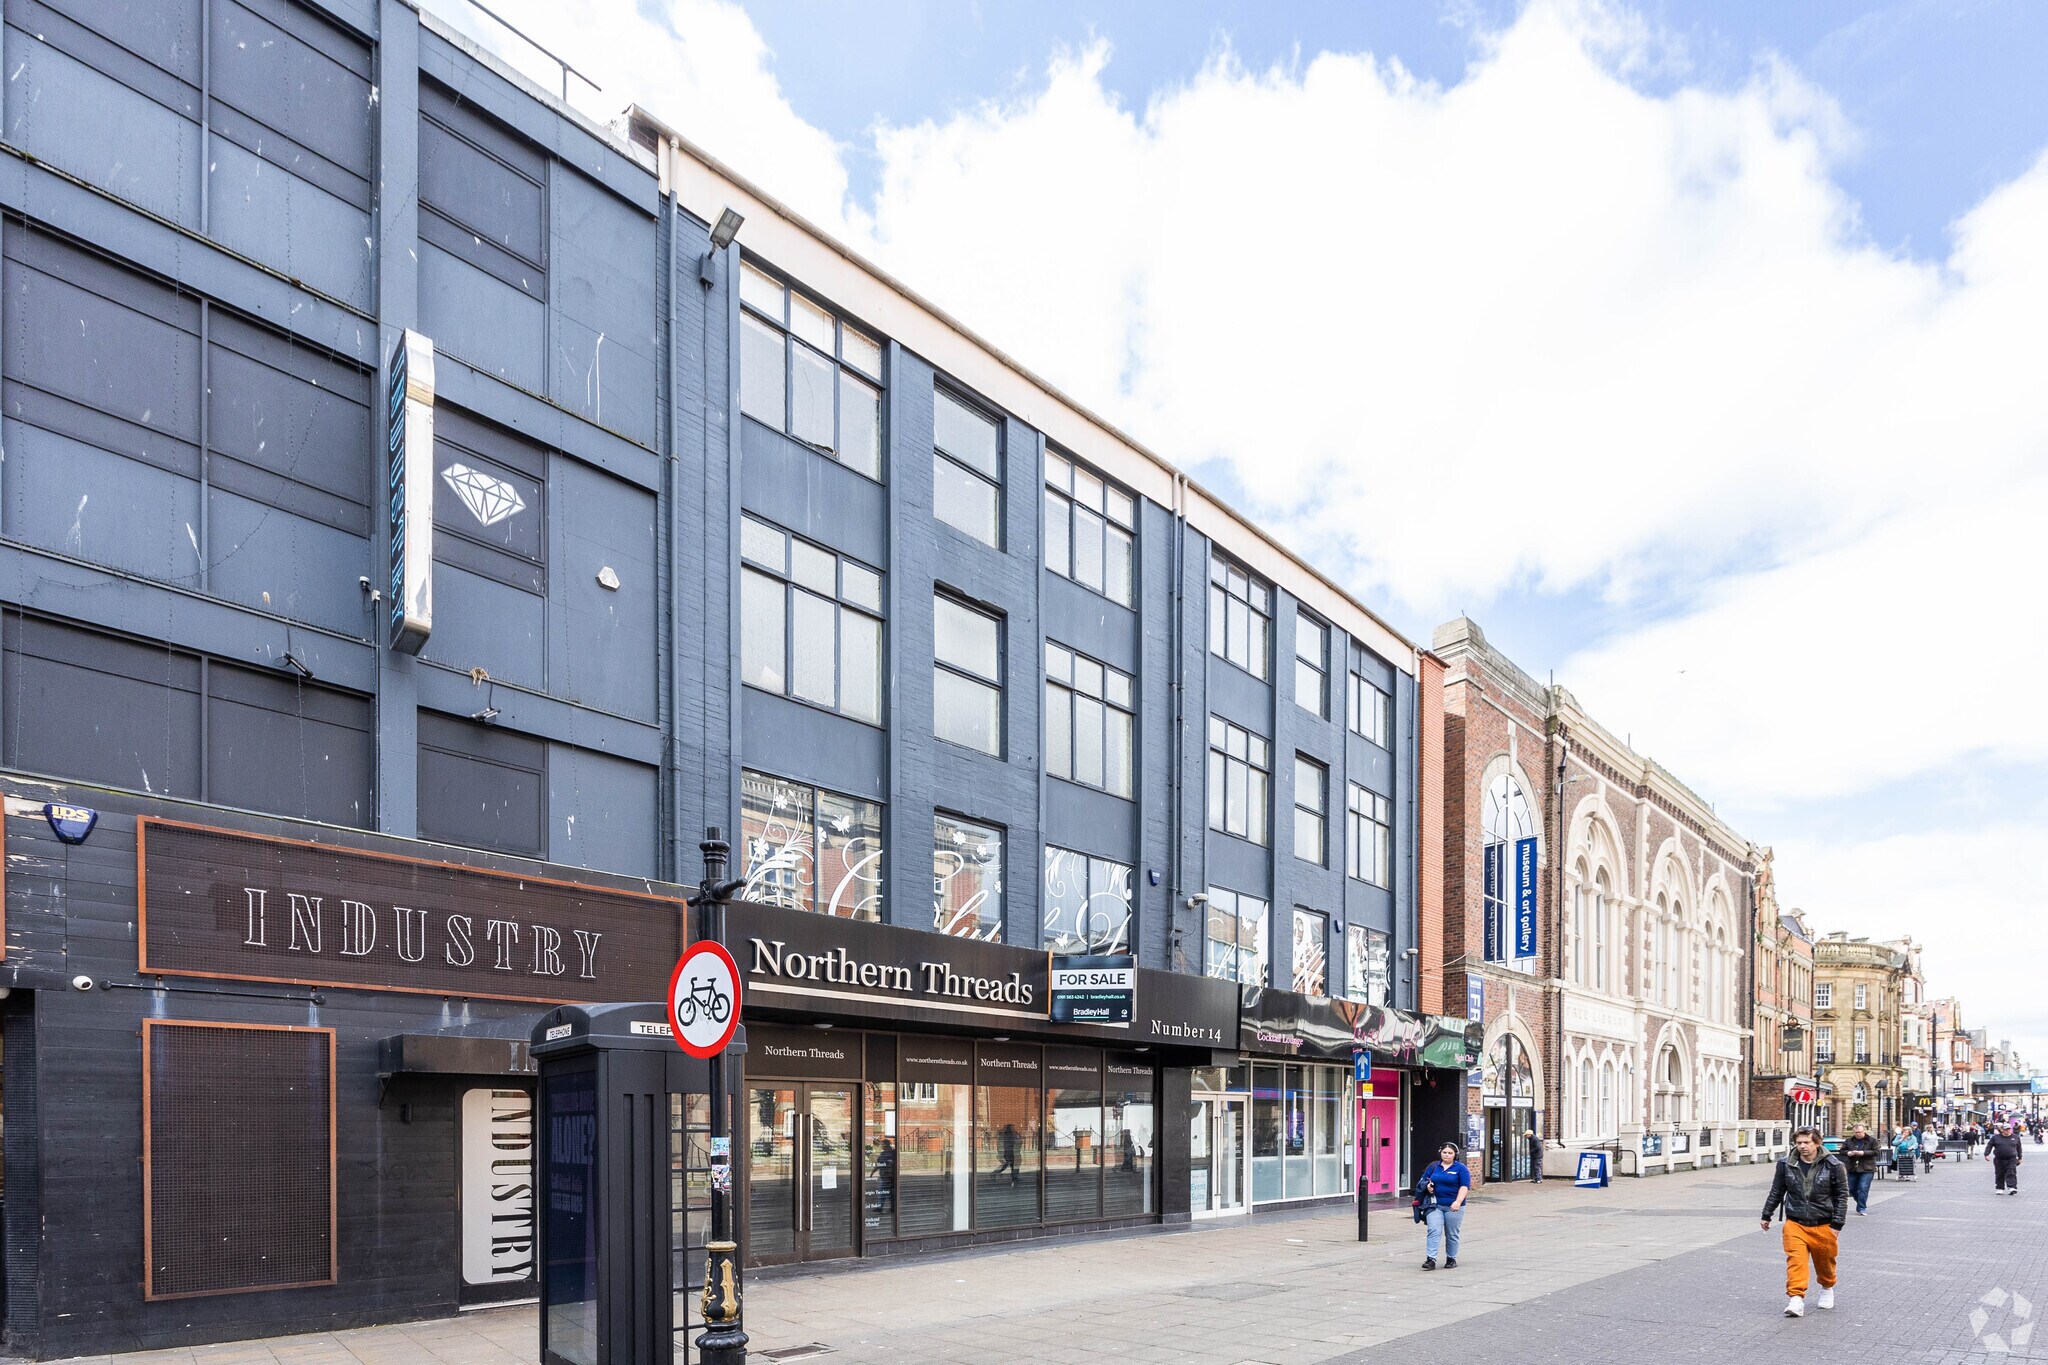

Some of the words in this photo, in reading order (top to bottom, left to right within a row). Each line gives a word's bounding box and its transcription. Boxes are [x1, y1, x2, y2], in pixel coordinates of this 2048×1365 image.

[52, 805, 90, 820] IDS
[1522, 843, 1531, 887] museum
[1522, 888, 1532, 898] &
[1522, 900, 1531, 915] art
[244, 888, 602, 979] INDUSTRY
[1520, 916, 1531, 952] gallery
[750, 938, 914, 991] Northern
[920, 961, 1033, 1005] Threads
[1059, 973, 1087, 986] FOR
[1090, 973, 1126, 985] SALE
[549, 1026, 571, 1039] TELEPHONE
[1150, 1019, 1205, 1039] Number
[1208, 1028, 1222, 1043] 14
[1257, 1030, 1281, 1042] Cocktail
[1282, 1034, 1304, 1047] Lounge
[765, 1045, 807, 1057] Northern
[809, 1048, 845, 1059] Threads
[906, 1057, 968, 1066] www.northernthreads.co.uk
[980, 1058, 1011, 1068] Northern
[1012, 1059, 1038, 1070] Threads
[1107, 1065, 1132, 1074] Northern
[1132, 1066, 1153, 1075] Threads
[551, 1114, 596, 1166] ALONE?
[491, 1088, 533, 1278] INDUSTRY
